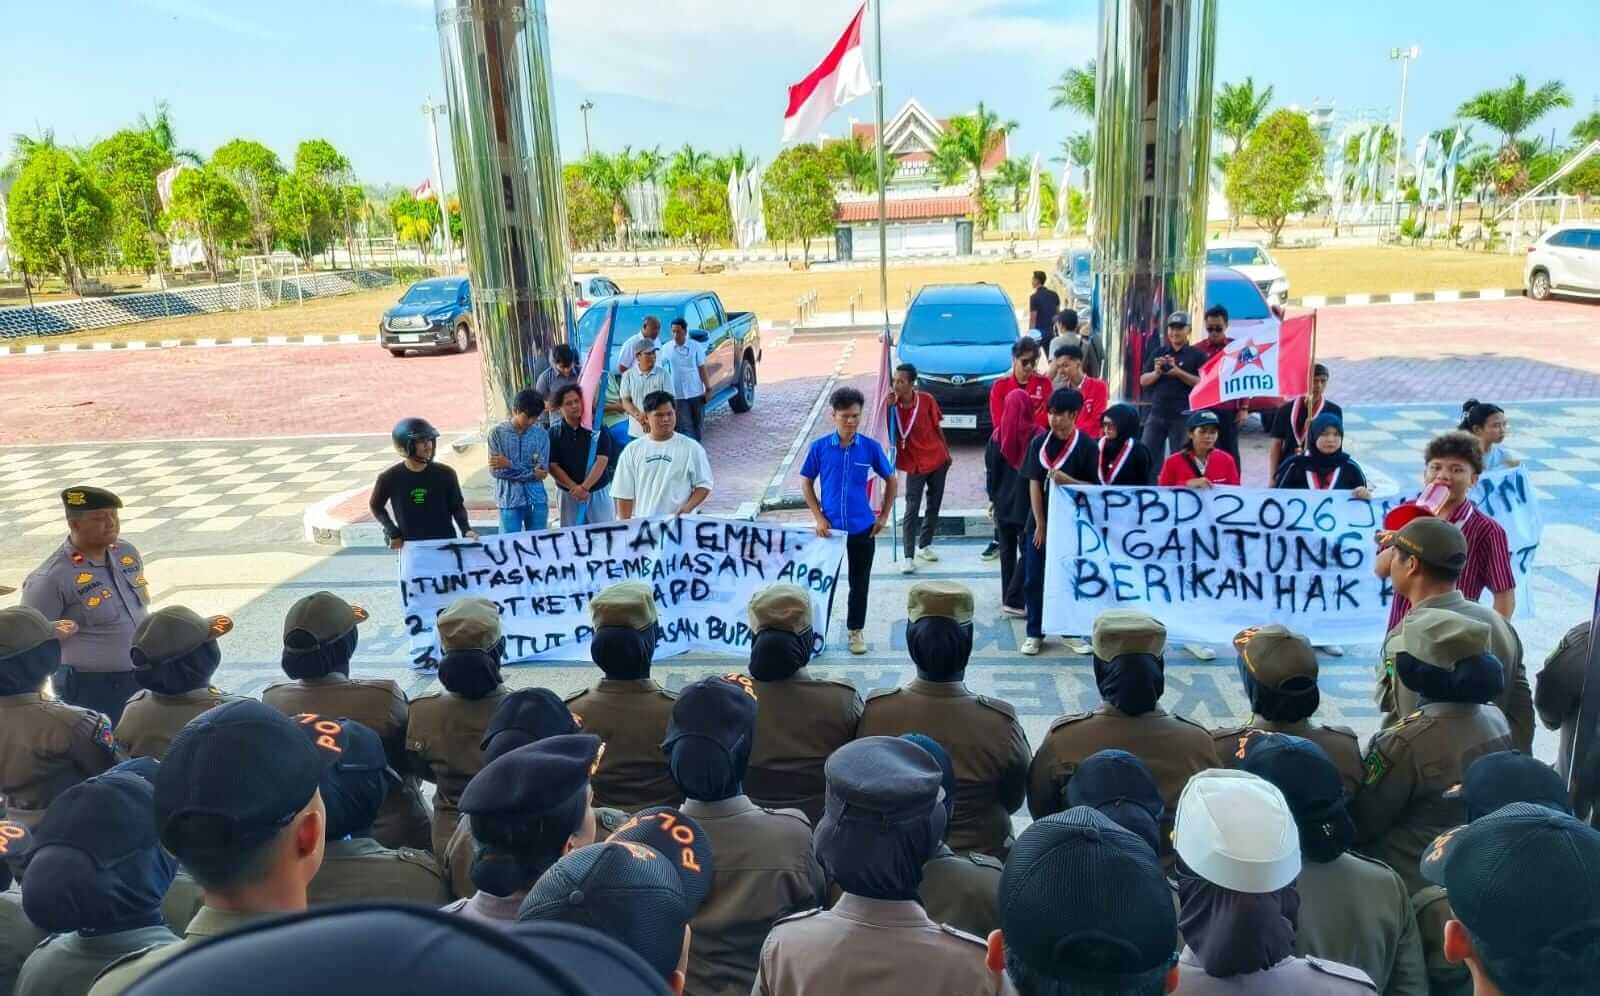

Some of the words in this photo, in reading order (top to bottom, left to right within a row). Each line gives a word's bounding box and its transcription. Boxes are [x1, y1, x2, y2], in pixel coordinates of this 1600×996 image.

[1074, 488, 1203, 526] APBD
[1214, 493, 1337, 533] 2026
[437, 517, 683, 573] TUNTUTAN
[586, 551, 765, 581] PEMBAHASAN
[776, 560, 834, 593] APBD
[1072, 557, 1263, 603] BERIKAN
[1275, 573, 1360, 613] HAK
